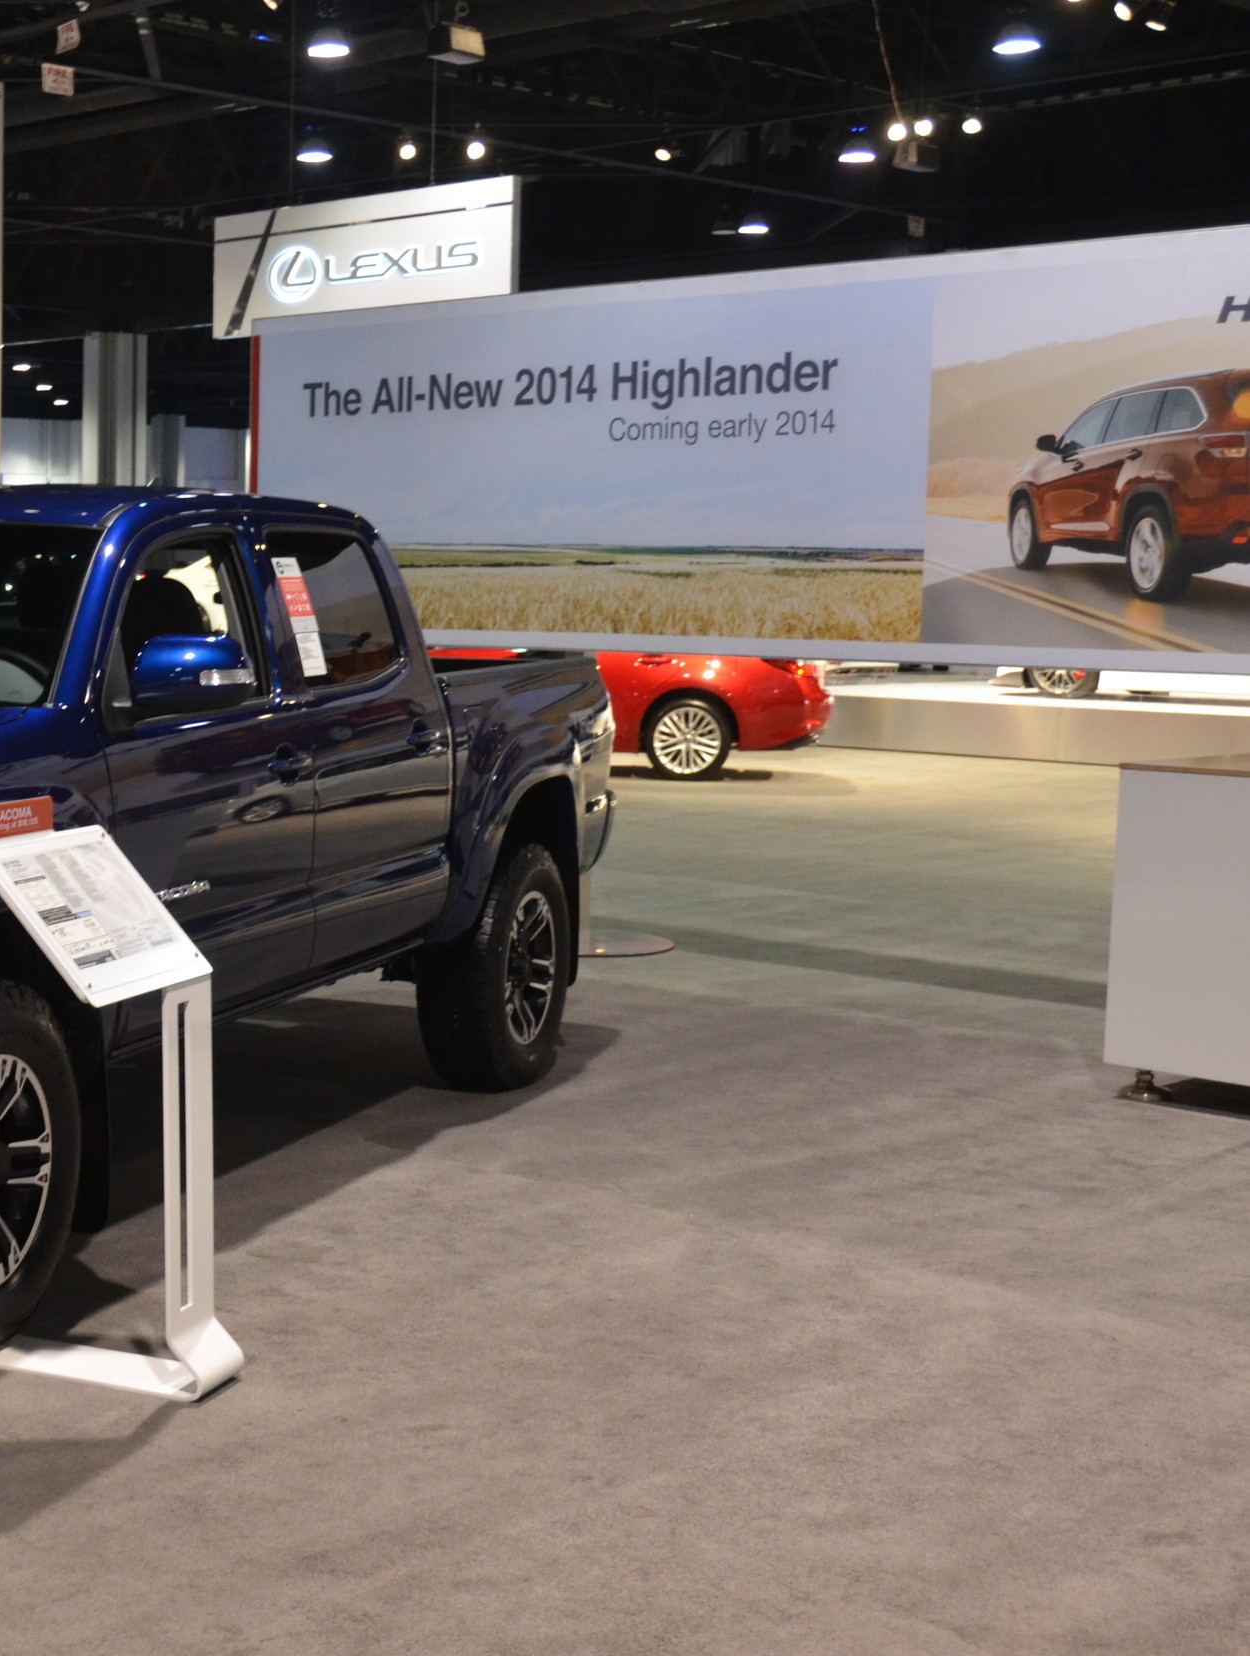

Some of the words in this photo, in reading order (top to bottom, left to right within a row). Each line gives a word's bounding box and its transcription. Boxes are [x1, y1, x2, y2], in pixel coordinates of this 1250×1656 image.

[324, 241, 479, 282] LEXUS
[302, 381, 363, 418] The
[371, 373, 504, 415] All-New
[514, 363, 598, 407] 2014
[611, 351, 839, 411] Highlander
[608, 415, 699, 446] Coming
[707, 412, 768, 443] early
[774, 408, 836, 437] 2014
[154, 880, 211, 901] ACOMA
